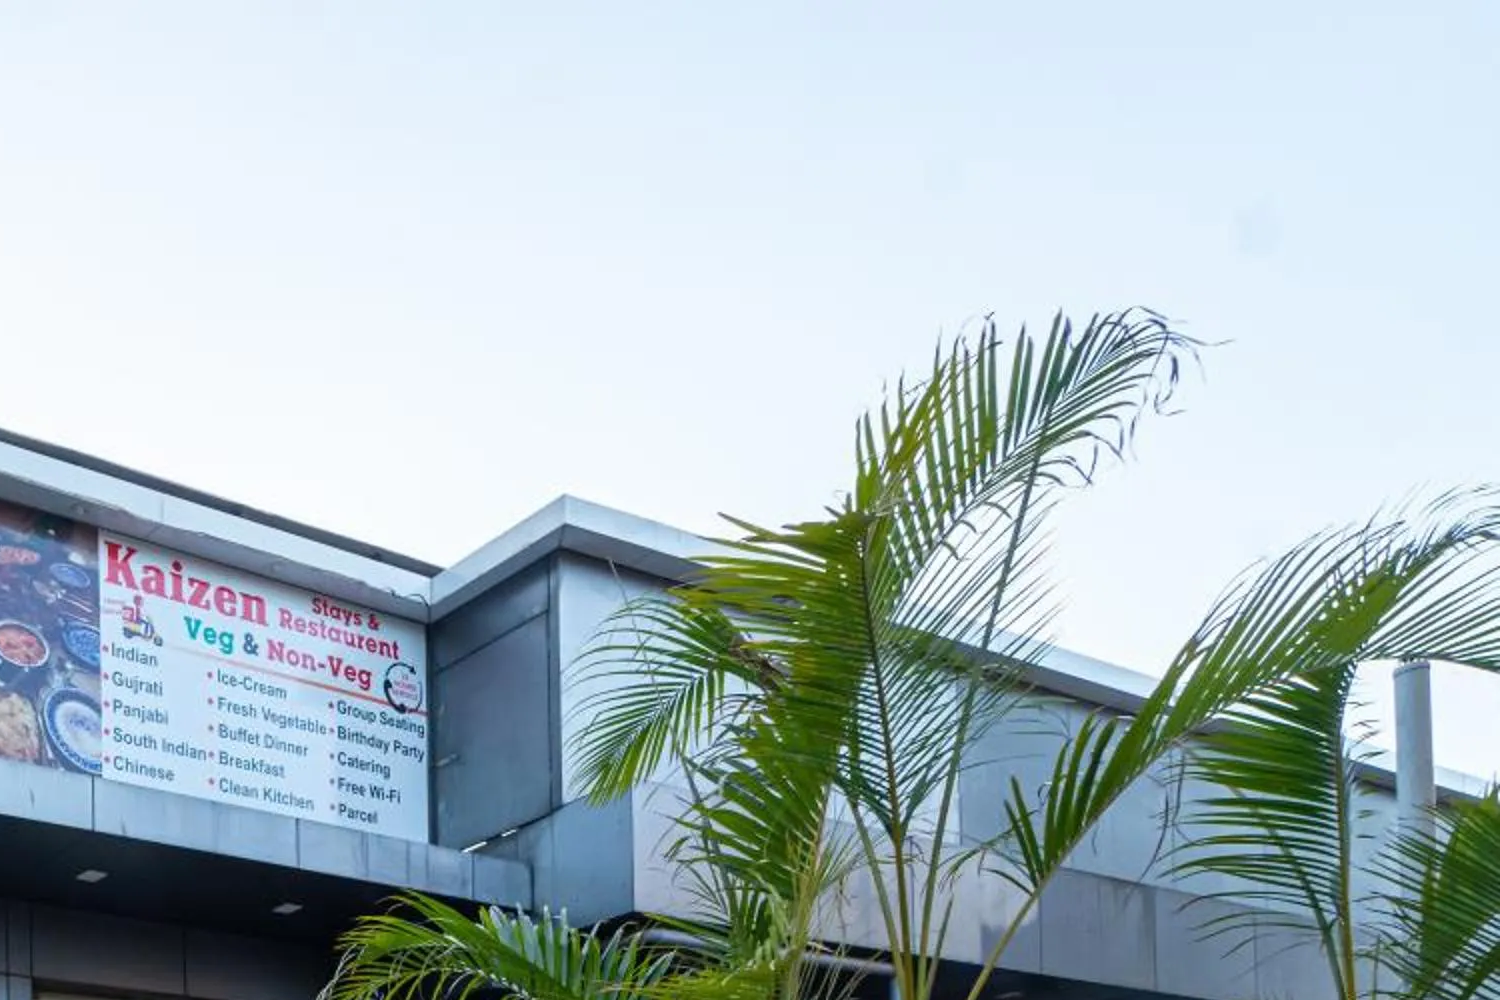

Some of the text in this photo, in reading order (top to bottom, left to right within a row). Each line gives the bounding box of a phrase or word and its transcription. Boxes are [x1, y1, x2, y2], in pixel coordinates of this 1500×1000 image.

[104, 541, 269, 627] Kaizen
[311, 597, 381, 631] Stays &
[278, 607, 400, 660] Restaurent
[111, 642, 158, 667] Indian
[184, 616, 235, 655] Veg
[243, 632, 259, 656] &
[266, 639, 373, 691] Non-Veg
[112, 671, 163, 696] Gujrati
[217, 668, 287, 700] Ice-Cream
[113, 699, 169, 725] Panjabi
[217, 697, 327, 735] Fresh Vegetable
[337, 700, 425, 738] Group Seating
[113, 727, 207, 761] South Indian
[218, 723, 308, 757] Buffet Dinner
[337, 725, 425, 763] Birthday Party
[113, 756, 175, 781] Chinese
[219, 751, 285, 778] Breakfast
[337, 751, 391, 779] Catering
[219, 777, 315, 811] Clean Kitchen
[337, 777, 401, 804] Free Wi-Fi
[338, 803, 378, 824] Parcel
